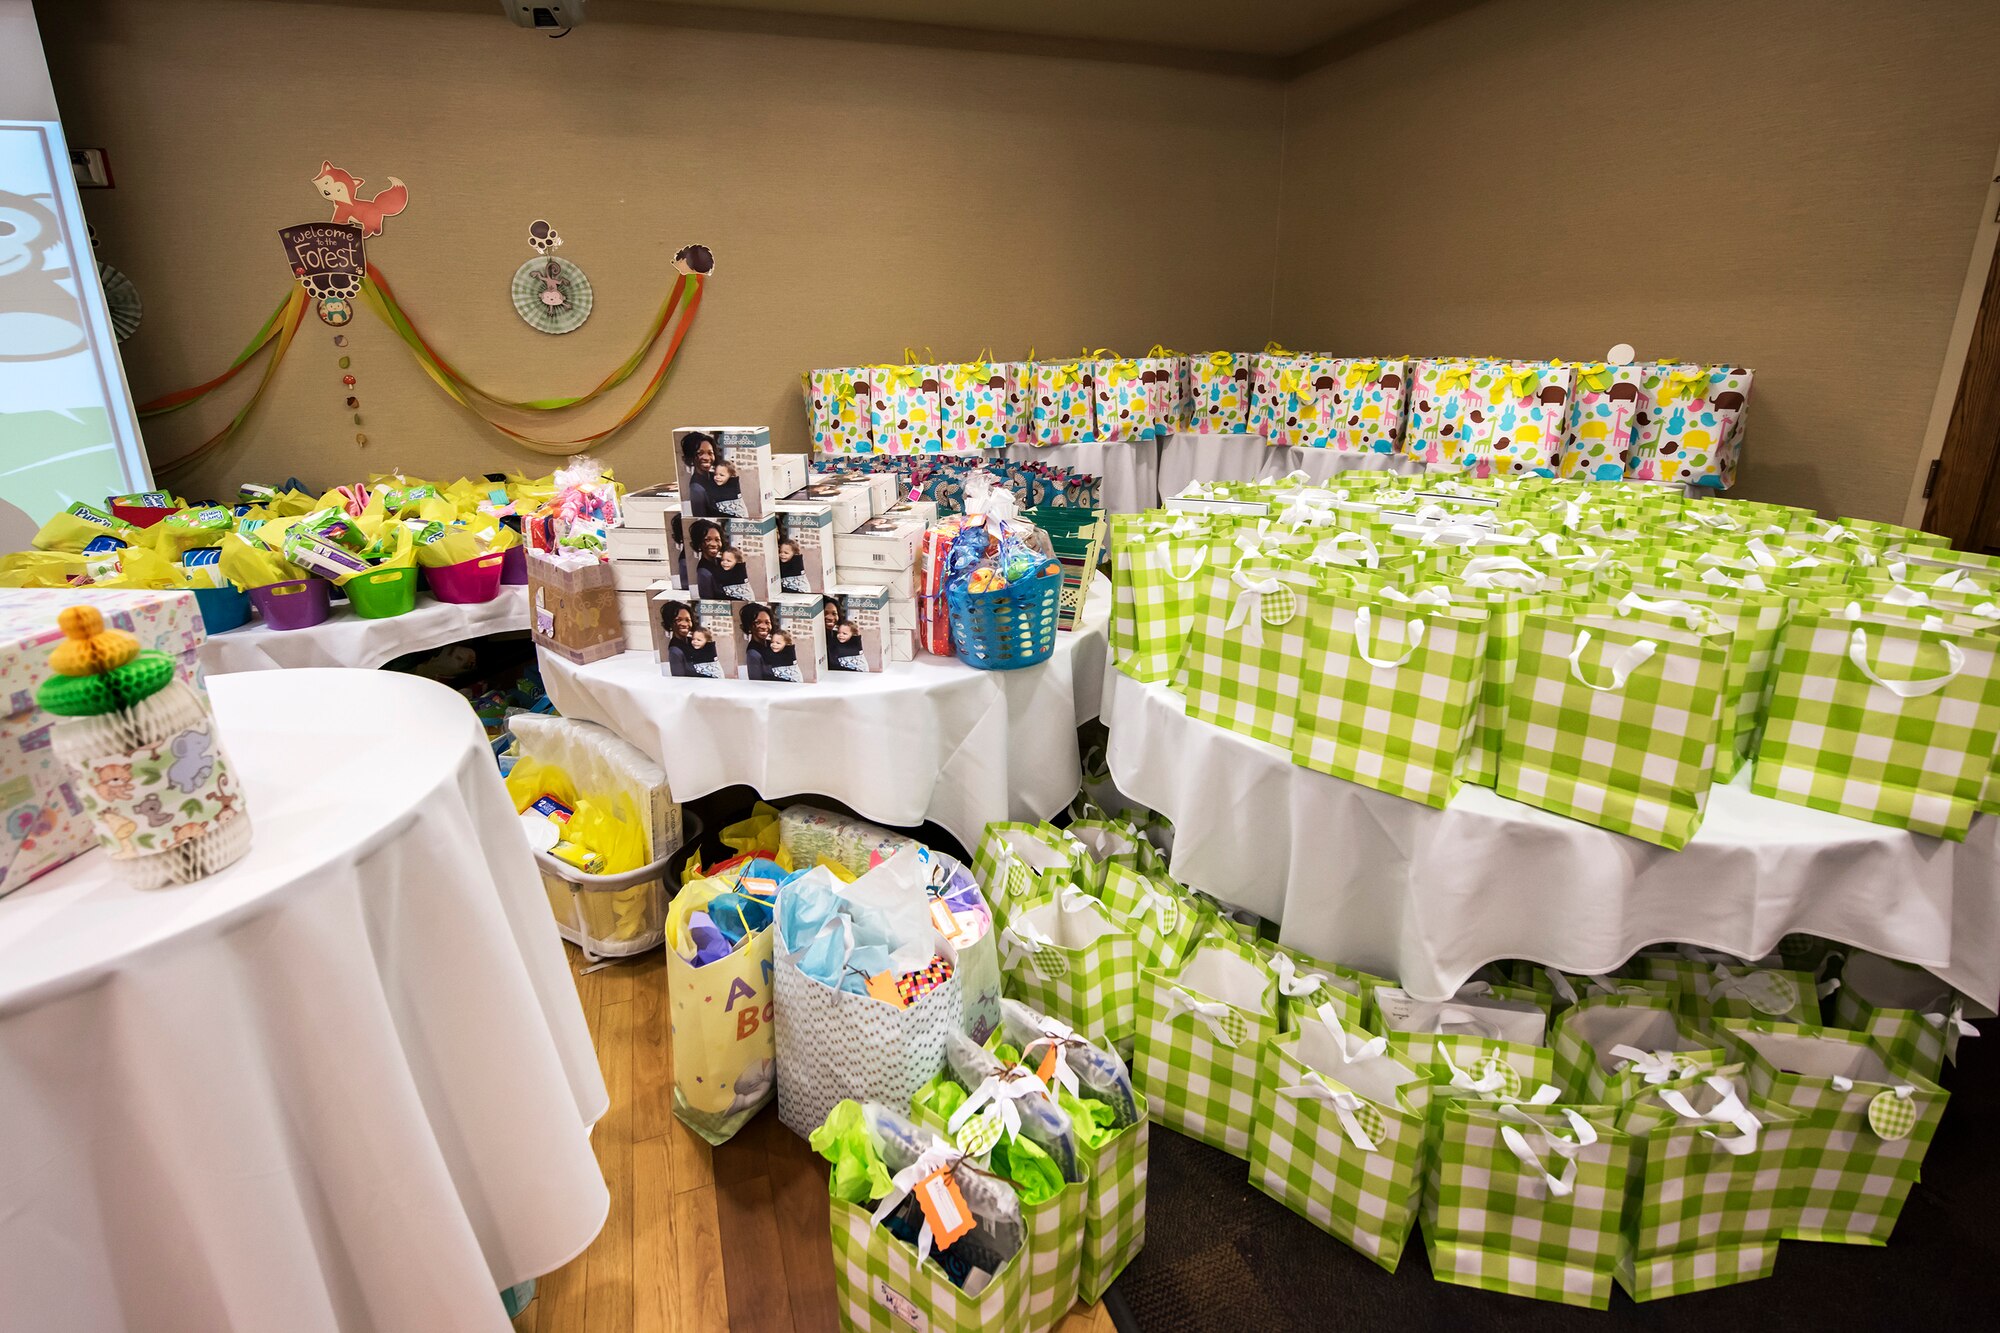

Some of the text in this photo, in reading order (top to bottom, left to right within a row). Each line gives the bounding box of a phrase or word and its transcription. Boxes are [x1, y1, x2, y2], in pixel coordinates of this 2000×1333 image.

[293, 225, 354, 243] welcome
[316, 238, 337, 246] to the
[295, 242, 358, 270] Forest
[74, 508, 112, 528] Pure'n
